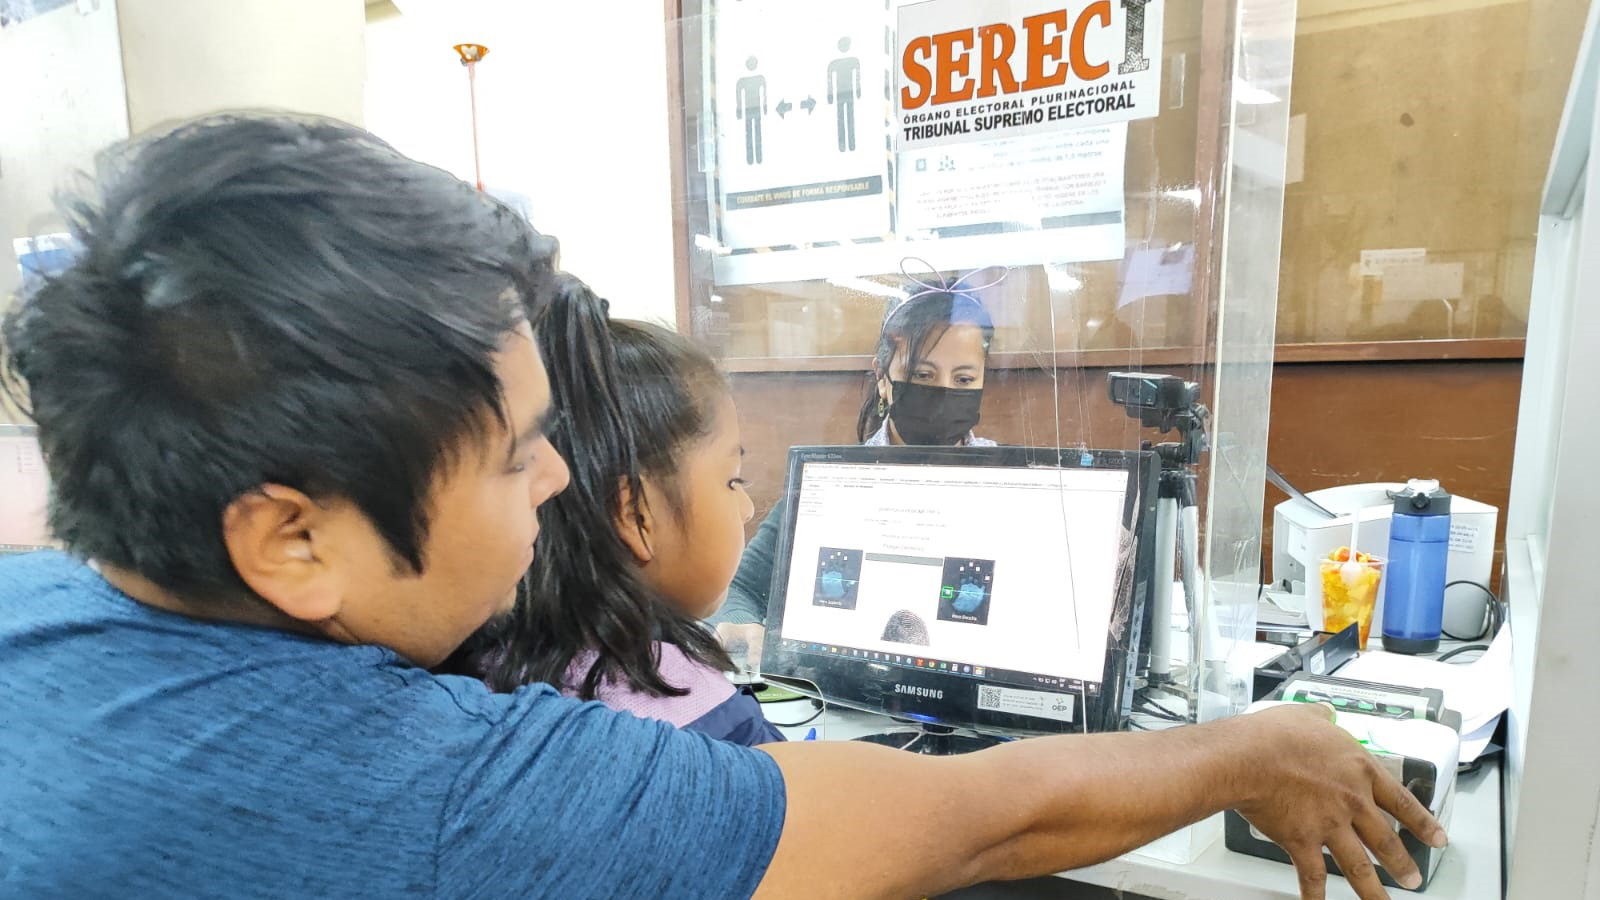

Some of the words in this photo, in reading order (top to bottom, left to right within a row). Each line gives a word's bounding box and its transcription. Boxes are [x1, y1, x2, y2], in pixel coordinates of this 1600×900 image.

[903, 109, 952, 125] ÓRGANO
[956, 99, 1025, 117] ELECTORAL
[1031, 80, 1135, 106] PLURINACIONAL
[903, 118, 971, 142] TRIBUNAL
[974, 106, 1044, 132] SUPREMO
[1048, 92, 1136, 121] ELECTORAL
[802, 187, 825, 198] FORMA
[825, 182, 869, 195] RESPONSABLE
[895, 684, 943, 699] SAMSUNG
